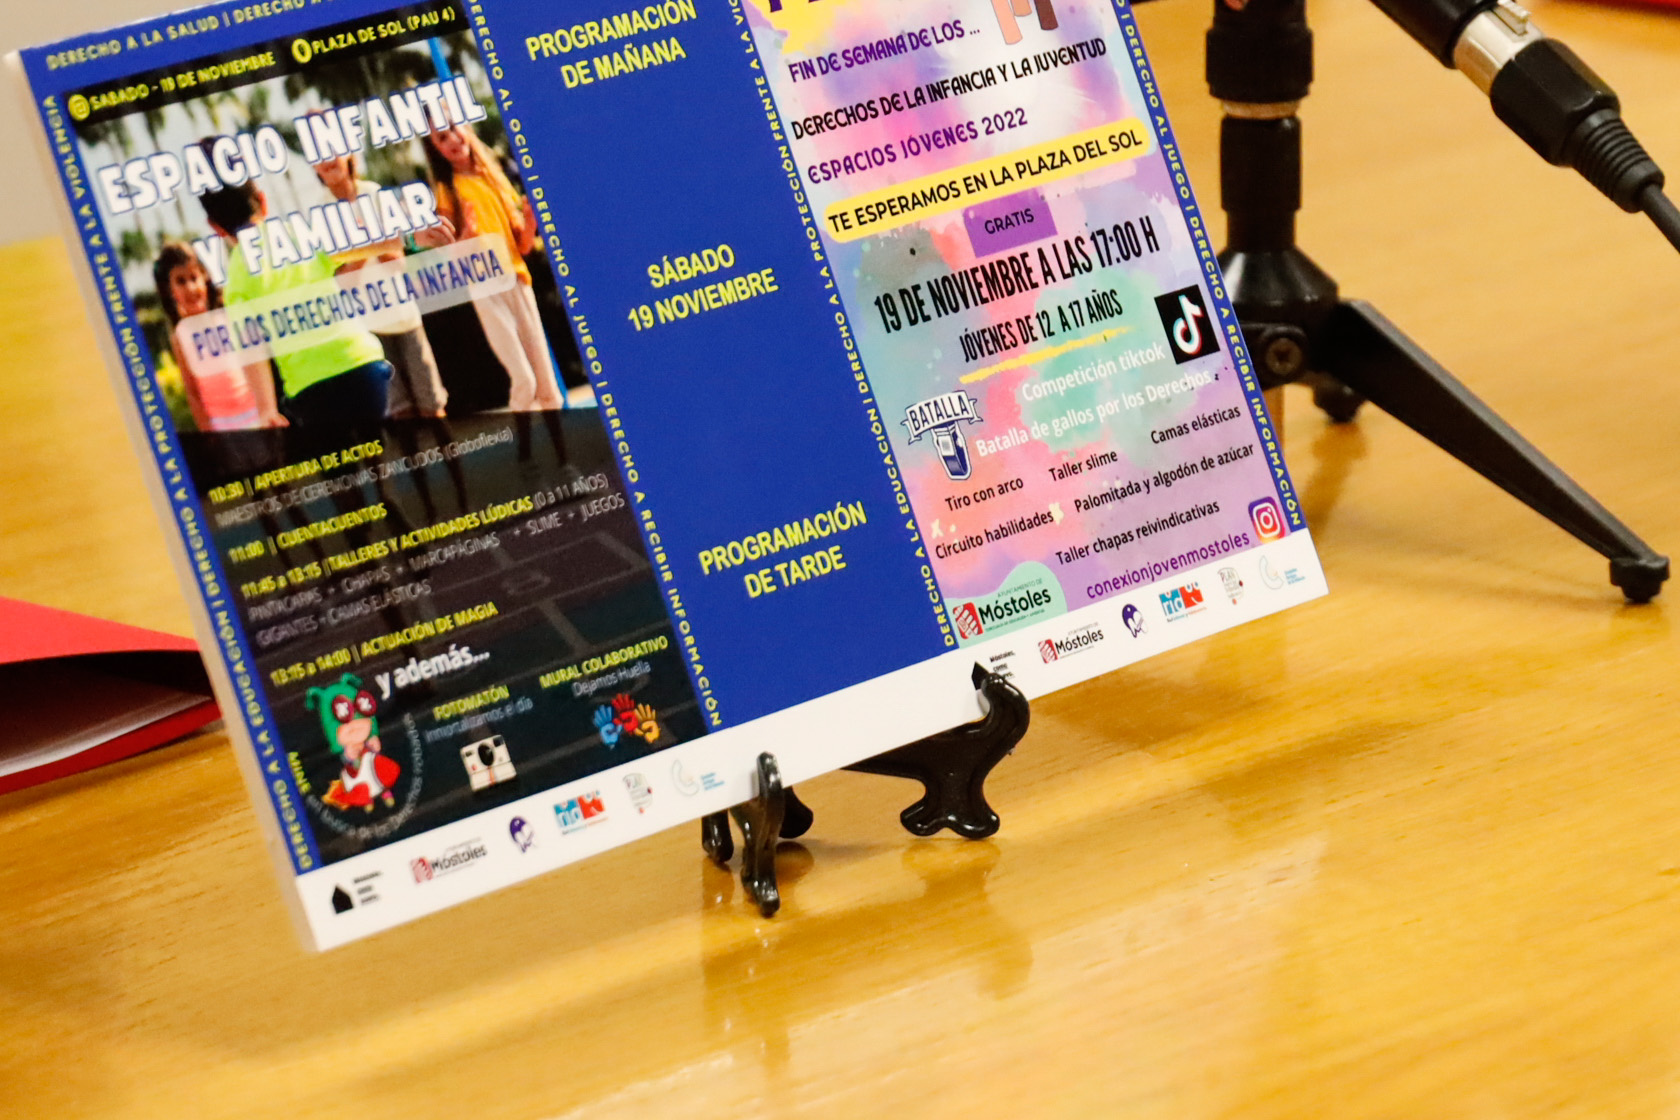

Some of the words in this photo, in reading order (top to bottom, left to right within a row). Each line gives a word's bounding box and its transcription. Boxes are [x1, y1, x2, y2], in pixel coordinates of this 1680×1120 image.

[310, 30, 357, 55] PLAZA
[354, 25, 378, 44] DE
[375, 18, 407, 39] SOL
[405, 9, 440, 31] (PAU
[439, 5, 457, 23] 4)
[560, 61, 593, 89] DE
[590, 31, 687, 81] MAÑANA
[739, 30, 754, 53] LA
[788, 58, 817, 83] FIN
[816, 52, 841, 75] DE
[840, 34, 908, 69] SEMANA
[907, 28, 933, 51] DE
[931, 19, 966, 45] LOS
[159, 76, 176, 92] 19
[175, 71, 197, 88] DE
[195, 51, 276, 83] NOVIEMBRE
[748, 57, 760, 70] A
[790, 99, 880, 140] DERECHOS
[880, 92, 905, 115] DE
[903, 86, 927, 109] LA
[925, 67, 998, 103] INFANCIA
[998, 63, 1012, 83] Y
[1010, 57, 1034, 80] LA
[1032, 37, 1109, 74] JUVENTUD
[754, 75, 783, 140] FRENTE
[95, 121, 294, 218] ESPACIO
[291, 72, 488, 167] INFANTIL
[805, 143, 898, 185] ESPACIOS
[897, 117, 980, 159] JÓVENES
[981, 107, 1029, 136] 2022
[776, 144, 825, 262] PROTECCIÓN
[827, 210, 854, 233] TE
[853, 179, 962, 226] ESPERAMOS
[962, 172, 989, 195] EN
[989, 165, 1014, 187] LA
[1014, 148, 1072, 180] PLAZA
[1072, 138, 1107, 163] DEL
[1107, 128, 1143, 153] SOL
[191, 231, 236, 288] Y
[234, 176, 442, 276] FAMILIAR
[983, 207, 1036, 236] GRATIS
[644, 238, 737, 289] SÁBADO
[818, 265, 834, 288] LA
[872, 291, 903, 334] 19
[897, 283, 931, 327] DE
[926, 251, 1040, 318] NOVIEMBRE
[1033, 245, 1057, 286] A
[1051, 234, 1094, 281] LAS
[1088, 220, 1144, 270] 17:00
[1139, 215, 1161, 254] H
[190, 324, 231, 361] POR
[232, 312, 272, 349] LOS
[268, 286, 367, 339] DERECHOS
[364, 279, 393, 312] DE
[390, 271, 420, 305] LA
[417, 248, 504, 297] INFANCIA
[625, 304, 656, 333] 19
[654, 268, 780, 325] NOVIEMBRE
[827, 293, 840, 305] A
[956, 315, 1019, 362] JÓVENES
[1015, 315, 1038, 345] DE
[1034, 309, 1056, 339] 12
[1055, 305, 1072, 333] A
[1067, 300, 1087, 329] 17
[1081, 282, 1124, 324] AÑOS
[833, 310, 869, 393] DERECHO
[1020, 356, 1119, 404] Competición
[1117, 341, 1166, 371] tiktok
[907, 392, 970, 432] BATALLA
[975, 425, 1029, 457] Batalla
[1029, 419, 1050, 439] de
[1050, 405, 1096, 437] gallos
[1095, 399, 1123, 423] por
[1121, 388, 1145, 410] los
[1144, 367, 1212, 402] Derechos
[1149, 420, 1190, 445] Camas
[1189, 403, 1242, 432] elásticas
[865, 407, 910, 515] EDUCACIÓN
[1048, 458, 1085, 482] Taller
[1083, 448, 1119, 471] slime
[1073, 479, 1142, 513] Palomitada
[1142, 479, 1153, 495] y
[1151, 460, 1201, 491] algodón
[1198, 454, 1216, 472] de
[1215, 441, 1256, 466] azúcar
[945, 492, 972, 512] Tiro
[972, 487, 995, 504] con
[995, 478, 1024, 496] arco
[695, 496, 868, 576] PROGRAMACIÓN
[904, 518, 920, 542] LA
[913, 546, 925, 559] A
[933, 531, 984, 560] Circuito
[984, 508, 1055, 543] habilidades
[1055, 542, 1091, 566] Taller
[1091, 527, 1137, 558] chapas
[1134, 498, 1220, 539] reivindicativas
[743, 568, 777, 599] DE
[775, 545, 847, 588] TARDE
[1083, 528, 1252, 603] conexionjovenmostoles
[919, 563, 955, 646] DERECHO
[977, 583, 1052, 625] Móstoles
[374, 672, 396, 701] y
[390, 635, 491, 688] además...
[538, 662, 582, 689] MURAL
[581, 634, 669, 675] COLABORATIVO
[1054, 625, 1104, 654] Móstoles
[432, 682, 510, 721] FOTOMATÓN
[570, 669, 620, 699] Dejamos
[618, 658, 651, 681] Huella
